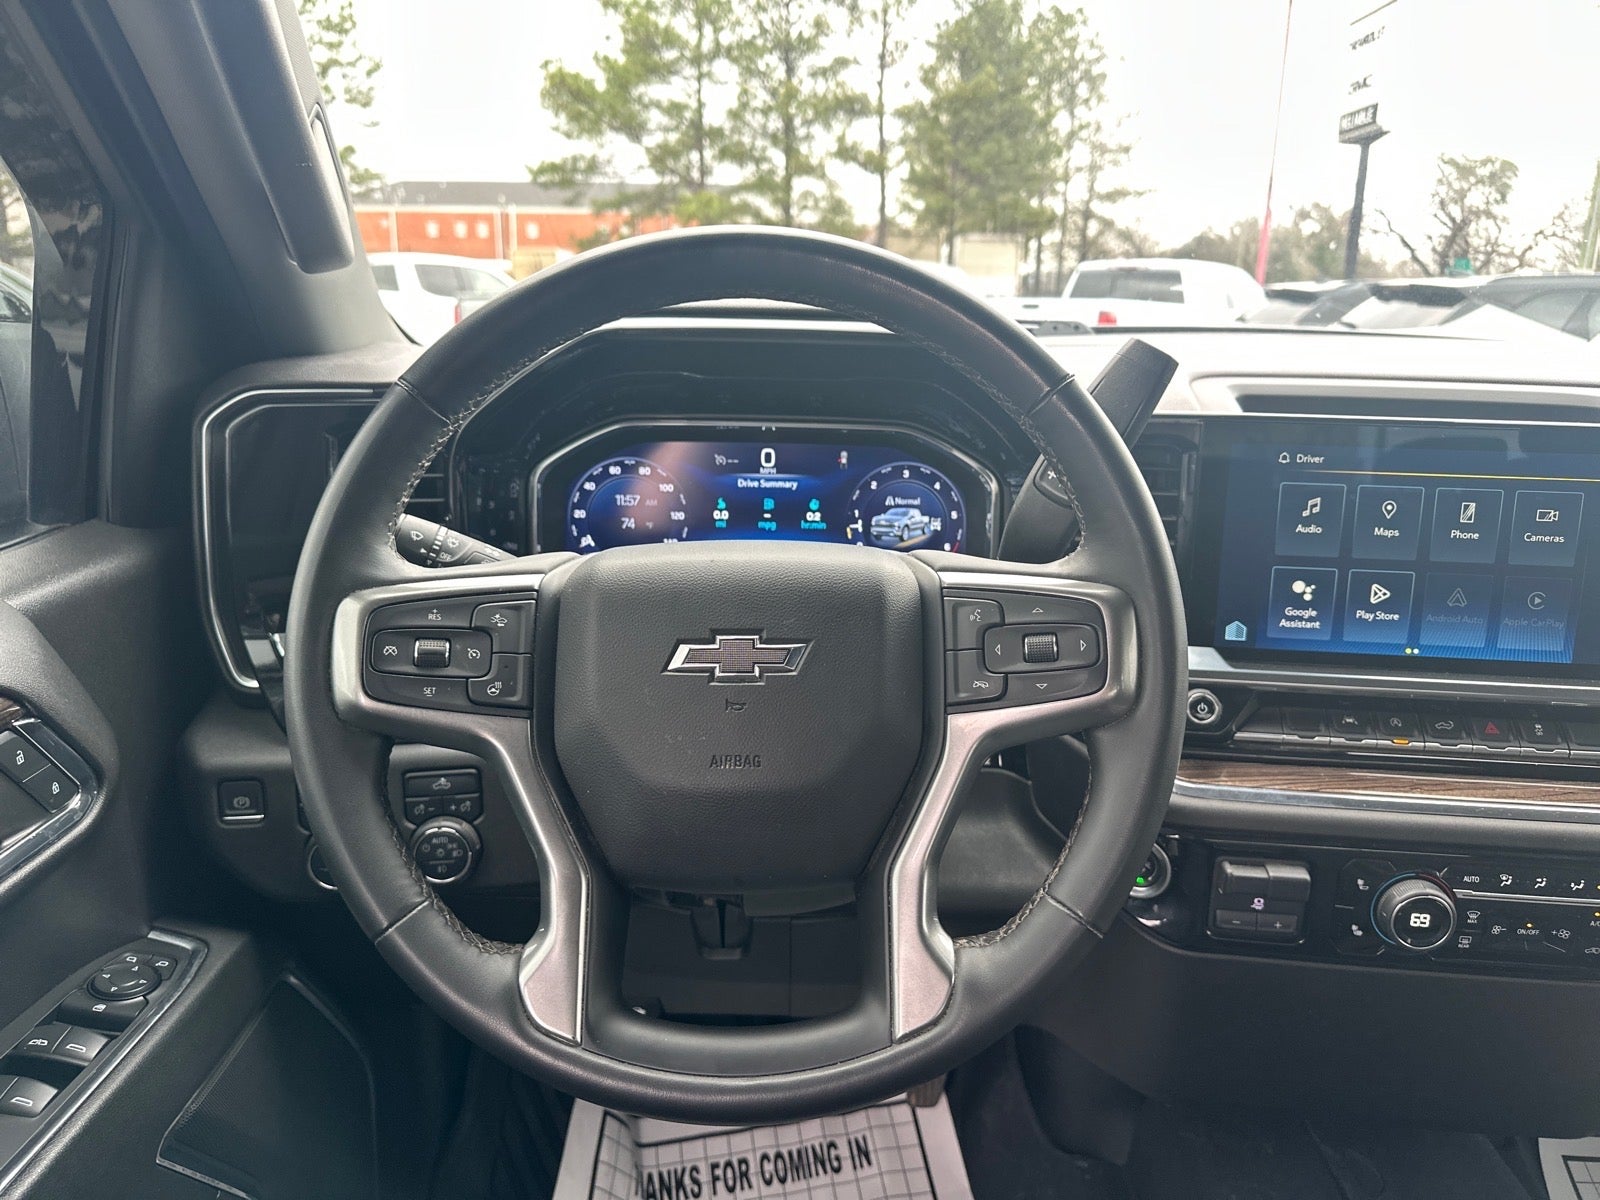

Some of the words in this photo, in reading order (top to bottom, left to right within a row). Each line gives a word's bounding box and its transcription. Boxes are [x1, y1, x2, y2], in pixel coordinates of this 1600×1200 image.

[761, 448, 775, 467] 0
[1296, 454, 1324, 464] Driver
[638, 466, 651, 476] 80
[902, 469, 910, 478] 3
[583, 481, 596, 491] 40
[659, 483, 674, 492] 100
[737, 478, 759, 488] Drive
[760, 479, 798, 490] Summary
[870, 480, 877, 490] 2
[933, 481, 941, 490] 4
[615, 494, 640, 506] 11:57
[894, 497, 921, 506] Normal
[573, 509, 586, 519] 20
[670, 511, 686, 521] 120
[713, 510, 729, 520] 0.0
[950, 510, 958, 520] 5
[621, 517, 635, 529] 74
[757, 521, 777, 531] mpg
[1295, 524, 1323, 534] Audio
[1374, 527, 1400, 538] Maps
[1450, 529, 1480, 540] Phone
[1523, 532, 1565, 543] Cameras
[428, 613, 441, 621] RES
[1284, 607, 1318, 619] Google
[1355, 610, 1375, 622] Play
[1375, 610, 1400, 621] Store
[1279, 618, 1321, 629] Assistant
[1426, 614, 1461, 623] Android
[1462, 615, 1484, 624] Auto
[1503, 617, 1529, 627] Apple
[1530, 618, 1565, 629] CarPlay
[423, 687, 436, 695] SET
[709, 754, 762, 769] AIRBAG
[1463, 875, 1480, 883] AUTO
[1409, 912, 1431, 928] 69
[710, 1156, 753, 1197] FOR
[760, 1139, 842, 1186] COMING
[847, 1134, 872, 1171] IN
